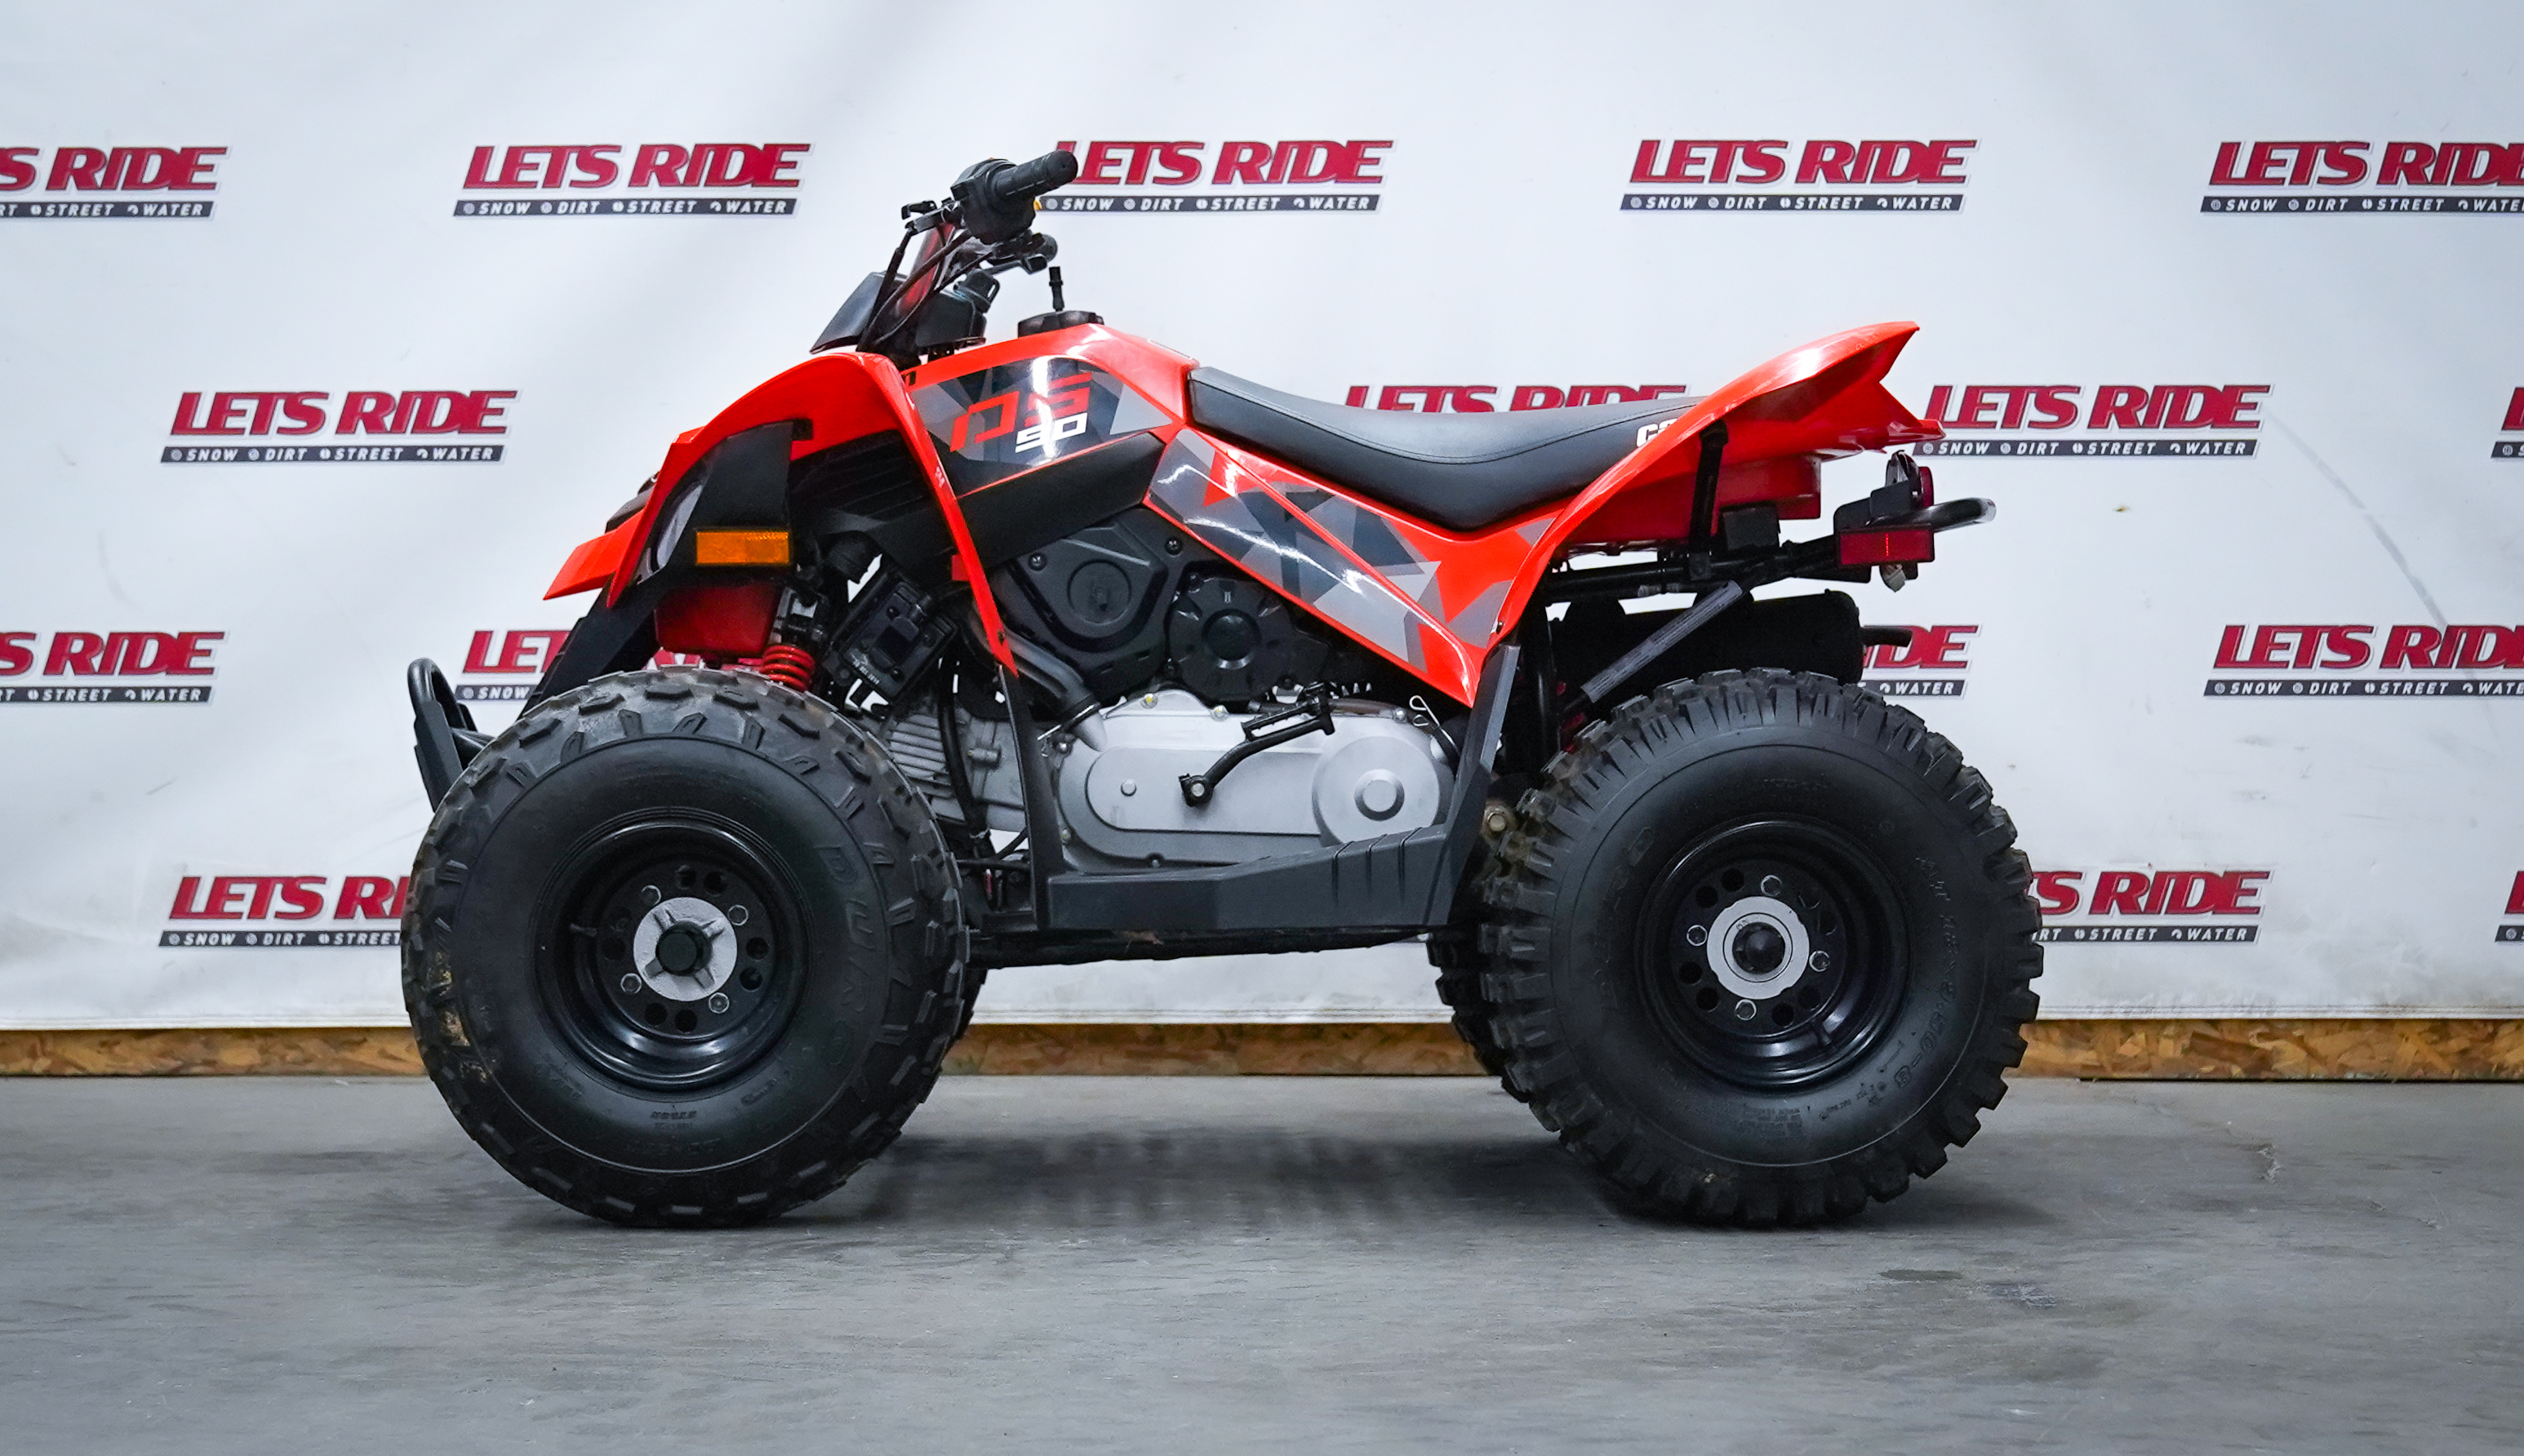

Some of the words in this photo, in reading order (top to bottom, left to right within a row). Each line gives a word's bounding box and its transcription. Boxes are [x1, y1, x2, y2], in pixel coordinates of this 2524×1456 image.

[46, 147, 227, 190] RIDE
[464, 144, 620, 189] LETS
[629, 143, 810, 188] RIDE
[1056, 140, 1204, 184] LETS
[1213, 140, 1392, 184] RIDE
[1630, 140, 1789, 184] LETS
[1795, 140, 1976, 184] RIDE
[2211, 140, 2370, 185] LETS
[478, 202, 531, 214] SNOW
[557, 202, 602, 215] DIRT
[626, 202, 698, 214] STREET
[726, 202, 787, 214] WATER
[1061, 198, 1114, 210] SNOW
[1140, 198, 1184, 211] DIRT
[1210, 198, 1281, 210] STREET
[1308, 198, 1370, 211] WATER
[1646, 197, 1699, 208] SNOW
[1724, 198, 1767, 209] DIRT
[1794, 197, 1864, 209] STREET
[1892, 198, 1953, 209] WATER
[2225, 199, 2277, 211] SNOW
[2304, 198, 2348, 211] DIRT
[2376, 199, 2445, 210] STREET
[2473, 200, 2524, 211] WATE
[45, 204, 114, 216] STREET
[143, 204, 203, 215] WATER
[171, 391, 328, 435] LETS
[335, 390, 516, 434] RIDE
[1924, 385, 2081, 429] LETS
[2087, 385, 2270, 428] RIDE
[186, 449, 238, 461] SNOW
[264, 449, 308, 460] DIRT
[334, 449, 404, 460] STREET
[433, 448, 493, 461] WATER
[1938, 442, 1990, 454] SNOW
[2016, 442, 2060, 455] DIRT
[2087, 442, 2157, 455] STREET
[2186, 442, 2246, 454] WATER
[2214, 624, 2374, 669] LETS
[43, 632, 224, 675] RIDE
[478, 686, 531, 699] SNOW
[1895, 682, 1954, 694] WATER
[2229, 682, 2282, 694] SNOW
[2308, 682, 2352, 694] DIRT
[2379, 682, 2449, 694] STREET
[2478, 682, 2524, 694] WATE
[42, 689, 112, 701] STREET
[140, 689, 202, 700] WATER
[170, 876, 327, 920] LETS
[2089, 871, 2269, 915] RIDE
[183, 934, 236, 945] SNOW
[262, 933, 306, 945] DIRT
[2031, 928, 2063, 941] IRT
[2089, 929, 2157, 940] STREET
[2187, 929, 2247, 940] WATER
